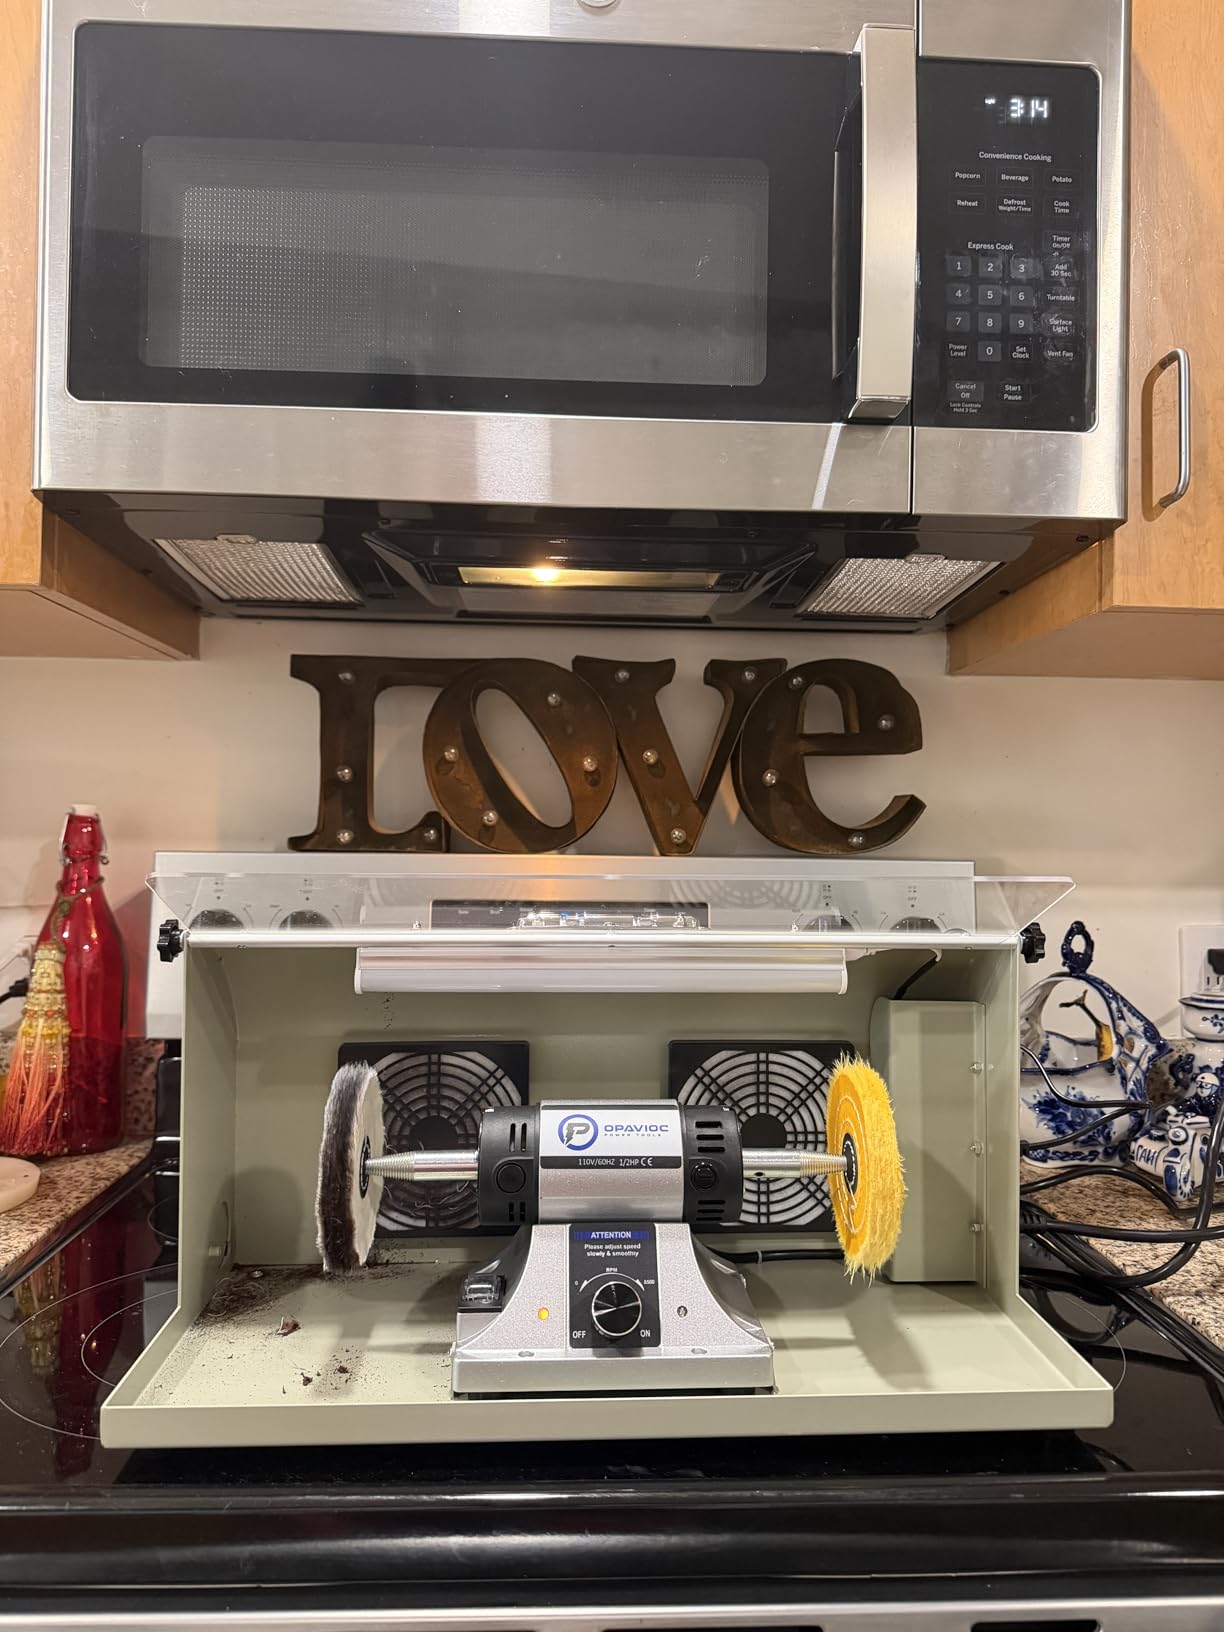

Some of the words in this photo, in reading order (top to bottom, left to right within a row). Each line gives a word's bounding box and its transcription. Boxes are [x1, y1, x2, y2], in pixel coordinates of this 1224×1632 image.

[1010, 98, 1048, 118] 3:14
[979, 152, 1022, 161] Convenience
[1024, 153, 1052, 162] Cooking
[1001, 174, 1029, 182] Beverage
[967, 242, 995, 250] Express
[956, 262, 961, 270] 1
[987, 263, 994, 271] 2
[1018, 264, 1025, 272] 3
[955, 289, 962, 297] 4
[987, 291, 993, 299] 5
[1018, 292, 1025, 300] 6
[955, 317, 962, 325] 7
[986, 318, 993, 327] 8
[1018, 319, 1025, 328] 9
[986, 346, 993, 355] 0
[604, 1124, 669, 1132] OPAVIOC
[578, 1158, 615, 1166] 110V/60HZ
[619, 1158, 639, 1166] 1/2HP
[591, 1231, 632, 1239] ATTENTION
[640, 1329, 651, 1338] ON
